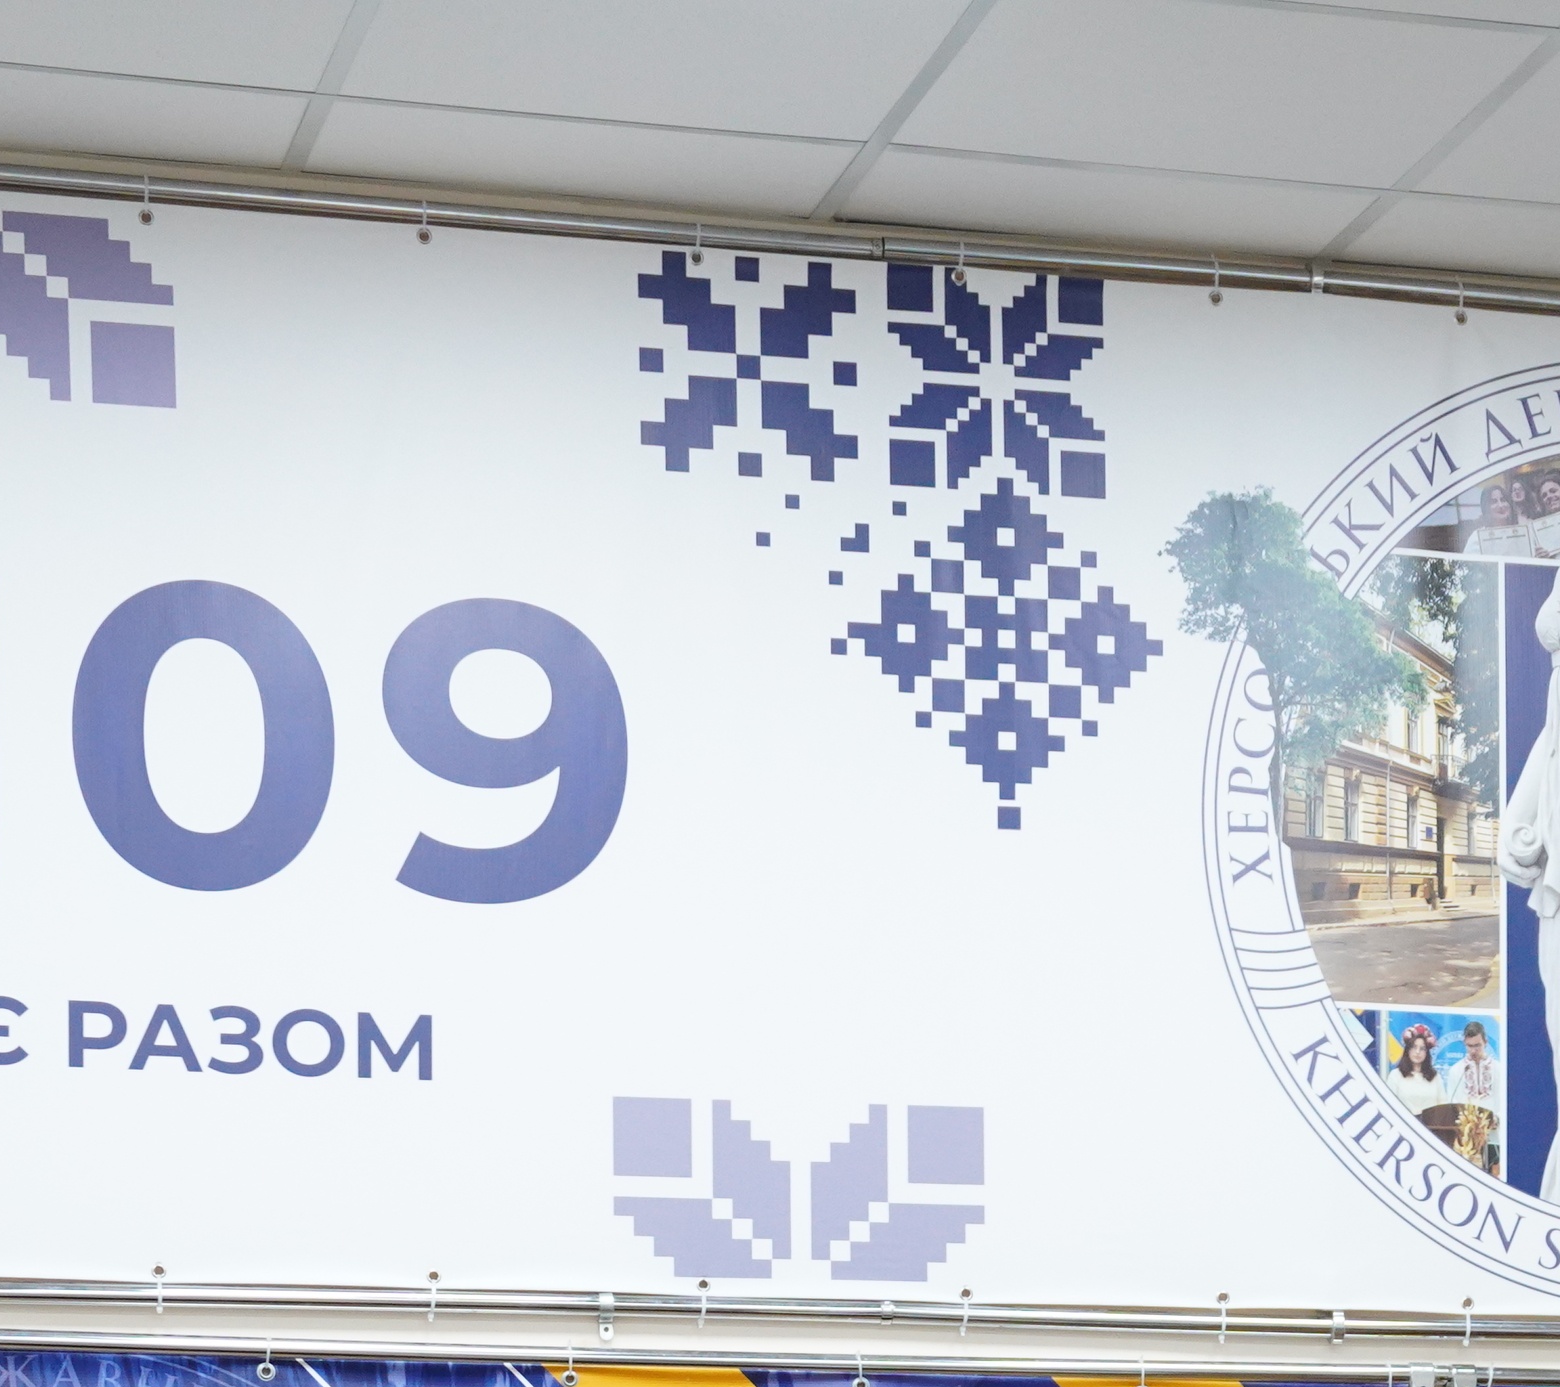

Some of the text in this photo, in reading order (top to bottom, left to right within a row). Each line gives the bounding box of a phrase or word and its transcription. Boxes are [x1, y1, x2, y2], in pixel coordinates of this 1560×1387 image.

[1227, 430, 1462, 888] ХЕРСОЬКИЙ
[64, 1002, 437, 1084] РАЗОМ
[1292, 1035, 1527, 1255] KHERSON
